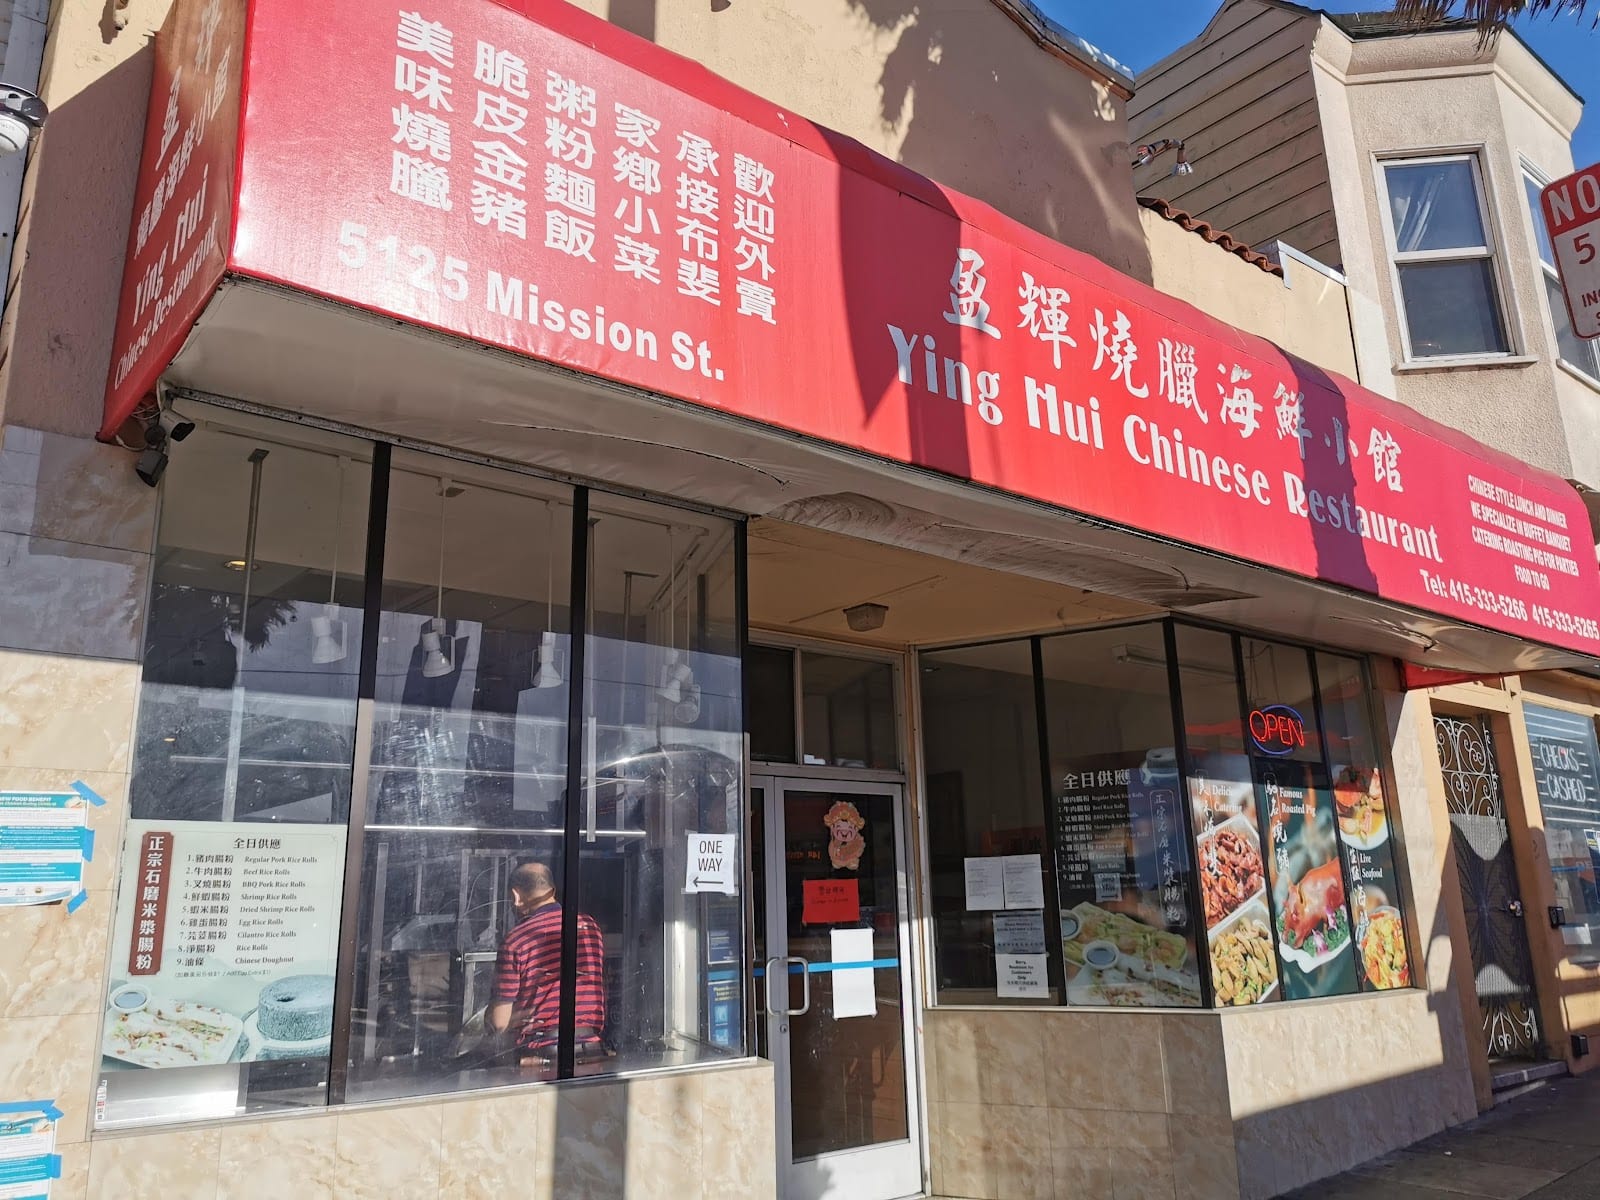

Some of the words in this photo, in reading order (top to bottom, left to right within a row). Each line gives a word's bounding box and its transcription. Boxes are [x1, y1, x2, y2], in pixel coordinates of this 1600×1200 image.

[390, 10, 453, 211] 美味燒臘
[471, 40, 529, 240] 脆皮金豬
[545, 69, 597, 263] 粥粉麵飯
[613, 101, 661, 285] 家鄉小菜
[1547, 173, 1600, 227] NO
[676, 129, 721, 306] 承接布斐
[133, 241, 168, 327] Ying
[172, 163, 208, 264] Hui
[733, 151, 777, 326] 歡迎外賣
[1573, 232, 1596, 265] 5
[115, 321, 152, 390] Chinese
[151, 211, 218, 337] Restaurant
[338, 219, 469, 301] 5125
[486, 269, 657, 362] Mission
[671, 333, 725, 382] St.
[942, 247, 1403, 493] 盈輝燒臘海鮮小館
[887, 323, 1003, 426] Ying
[1024, 375, 1104, 450] Hui
[1123, 414, 1271, 506] Chinese
[1283, 471, 1443, 563] Restaurant
[1468, 474, 1496, 501] CHINESE
[1495, 486, 1516, 509] STYLE
[1514, 494, 1535, 517] LUNCH
[1534, 502, 1546, 521] AND
[1545, 507, 1568, 530] DINNER
[1470, 500, 1482, 520] WE
[1481, 504, 1517, 534] SPECIALIZE
[1516, 518, 1524, 536] IN
[1523, 521, 1545, 543] BUFFET
[1544, 528, 1571, 552] BANQUET
[1471, 525, 1504, 552] CATERING
[1503, 536, 1534, 562] ROASTING
[1533, 547, 1545, 567] PIG
[1543, 550, 1557, 569] FOR
[1554, 554, 1579, 577] PARTIES
[1514, 564, 1533, 585] FOOD
[1531, 569, 1542, 589] TO
[1540, 572, 1550, 591] GO
[1419, 569, 1448, 599] Tel:
[1449, 578, 1529, 622] 415-333-5266
[1532, 604, 1600, 641] 415-333-5265
[1250, 710, 1305, 747] OPEN
[1540, 743, 1580, 772] CHECKS
[1063, 769, 1131, 790] 全日供應
[1279, 786, 1303, 799] Famous
[1547, 773, 1586, 803] CASHED
[1281, 803, 1305, 815] Roasted
[1306, 804, 1316, 818] Pig
[233, 838, 282, 849] 全日供應
[244, 856, 270, 864] Regular
[302, 856, 318, 864] Rolls
[699, 840, 723, 854] ONE
[1359, 853, 1372, 864] Live
[274, 868, 290, 876] Rolls
[698, 858, 723, 872] WAY
[1362, 867, 1383, 880] Seafood
[136, 836, 165, 970] 正宗石磨米漿腸粉
[240, 893, 264, 902] Shrimp
[240, 905, 259, 913] Dried
[259, 905, 284, 914] Shrimp
[237, 931, 264, 939] Cilantro
[280, 930, 297, 938] Rolls
[238, 919, 251, 927] Egg
[267, 918, 284, 926] Rolls
[235, 957, 260, 965] Chinese
[262, 955, 294, 965] Doughnut
